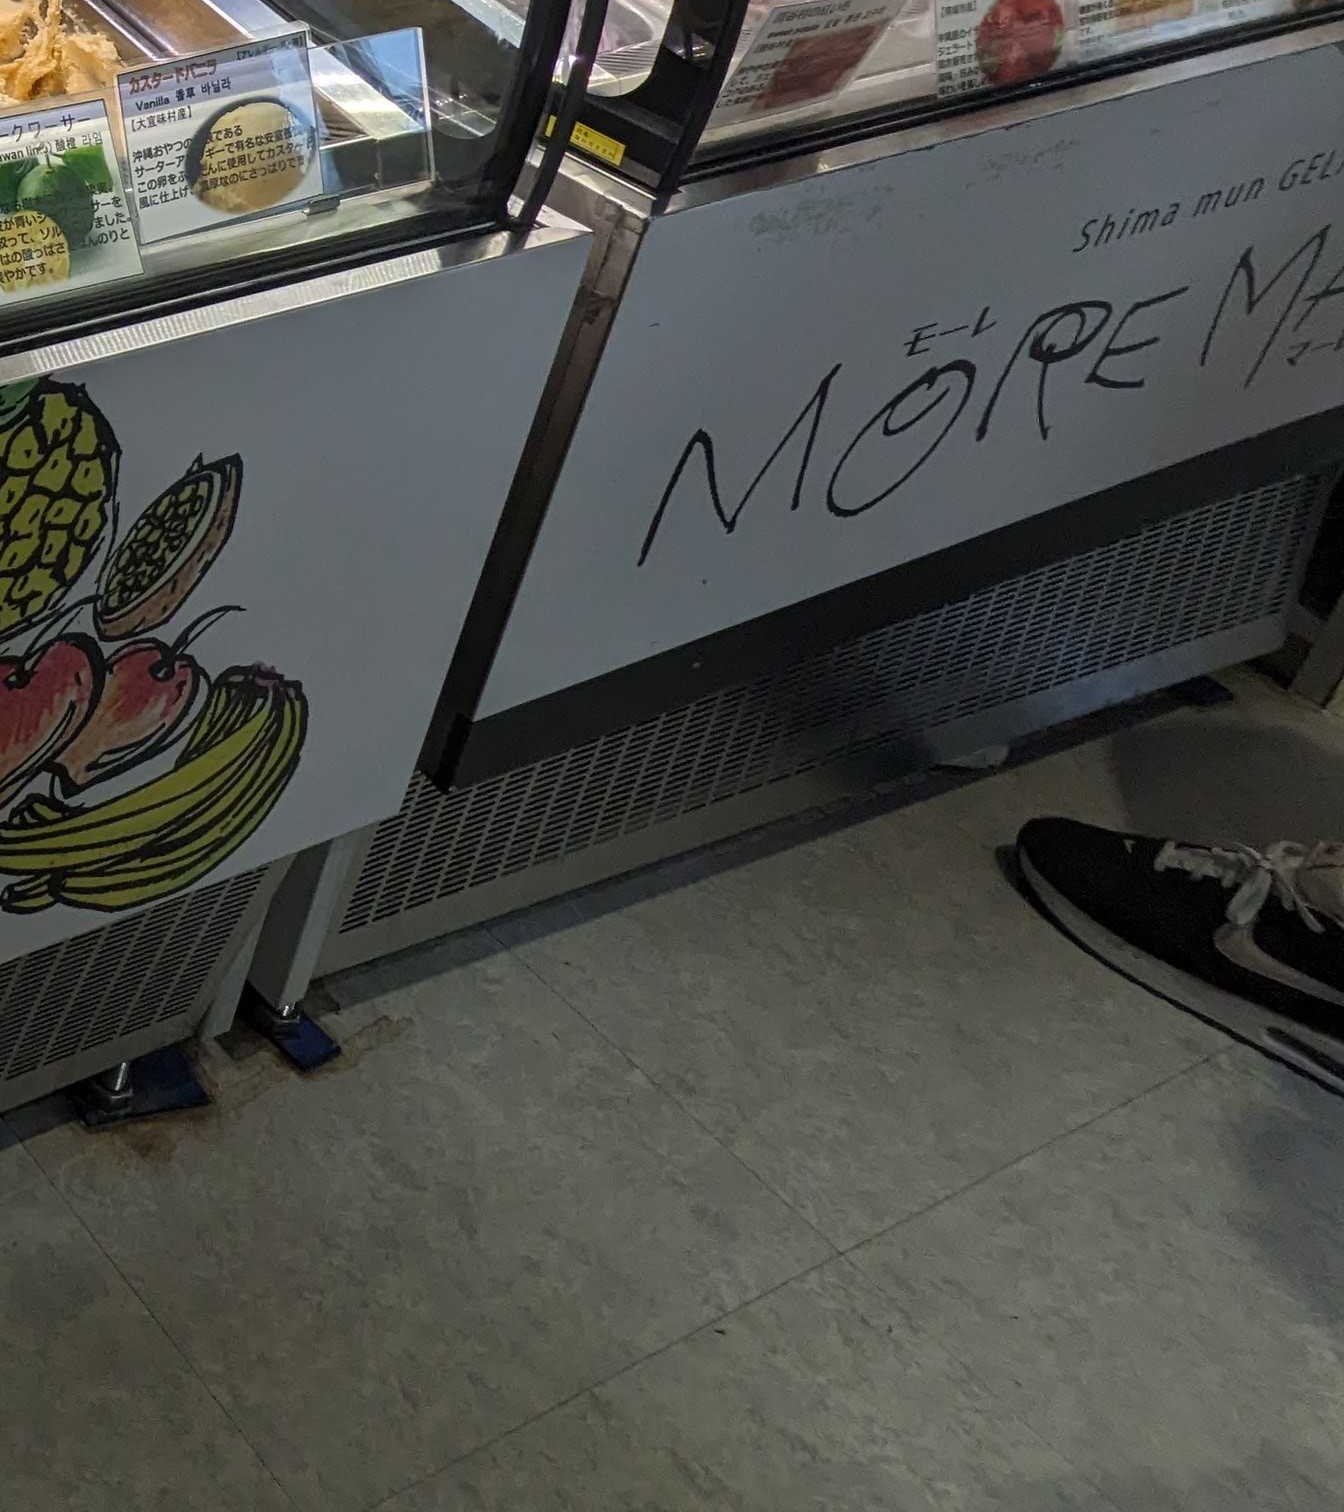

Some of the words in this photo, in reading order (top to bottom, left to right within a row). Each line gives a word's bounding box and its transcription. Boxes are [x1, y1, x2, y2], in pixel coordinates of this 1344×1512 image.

[135, 95, 171, 113] Vanilla
[1073, 202, 1181, 255] Shima
[1192, 177, 1265, 217] mun
[1278, 149, 1344, 192] GEL
[636, 286, 1191, 569] MORE
